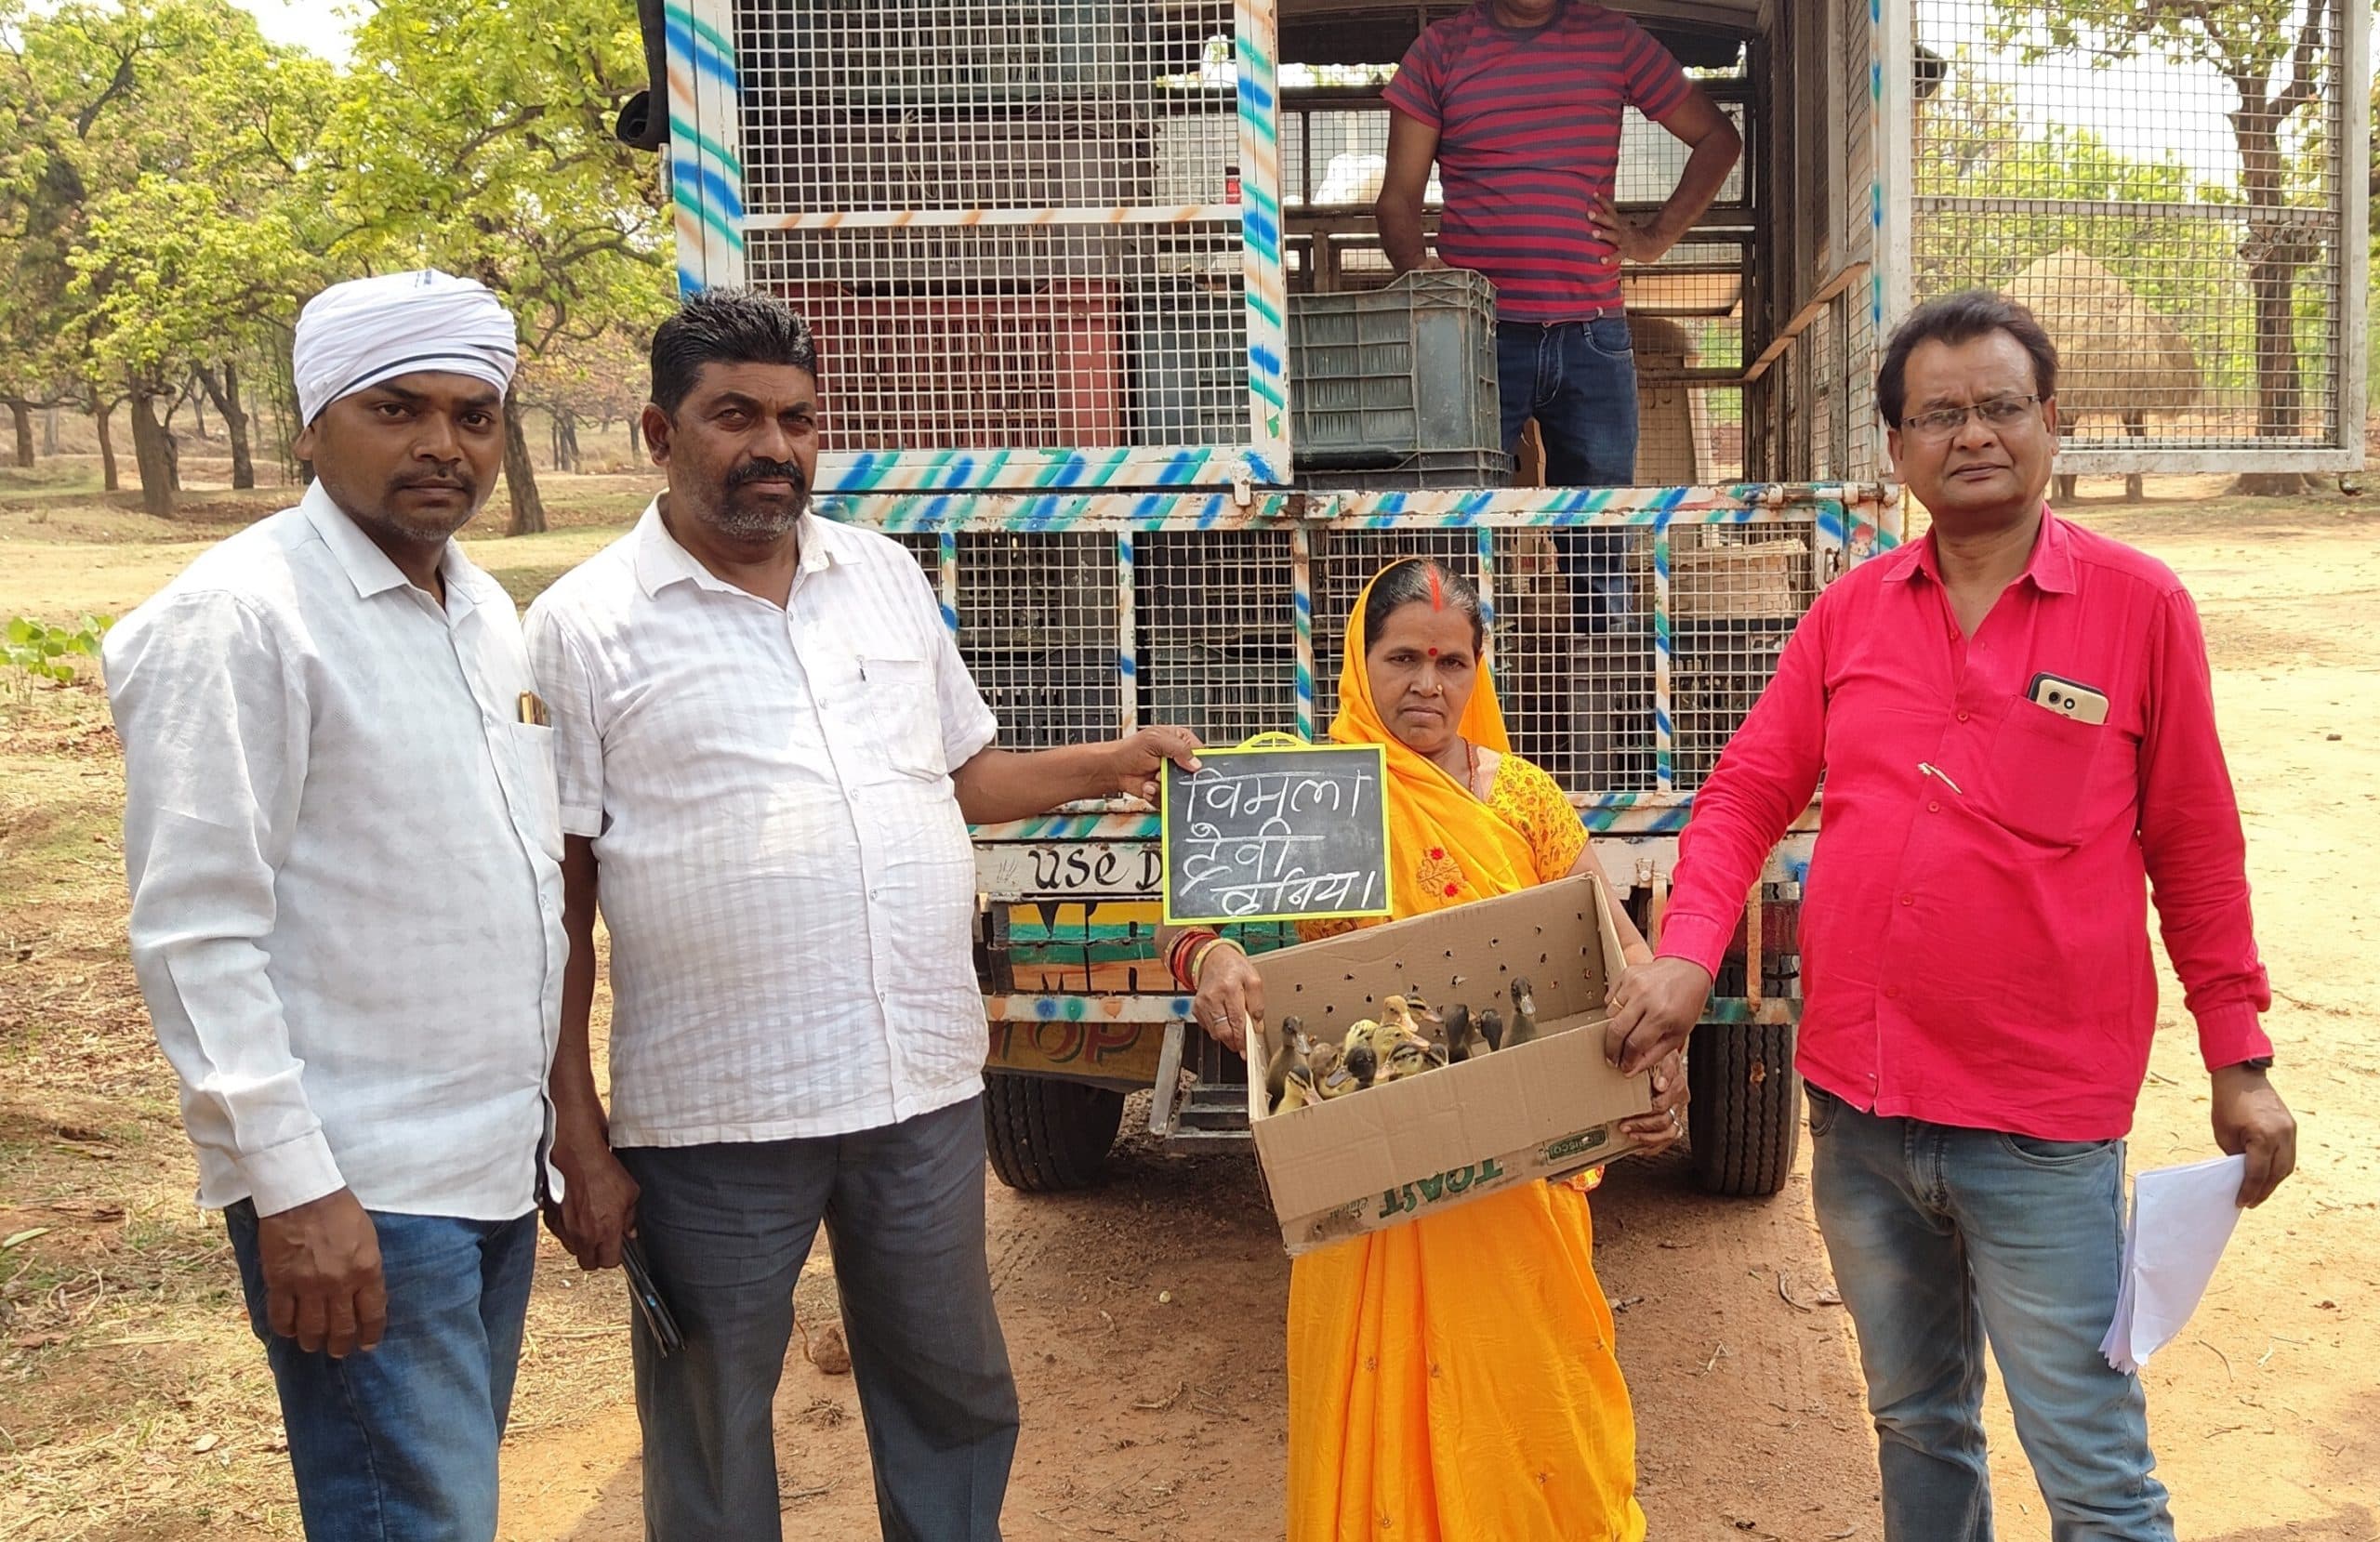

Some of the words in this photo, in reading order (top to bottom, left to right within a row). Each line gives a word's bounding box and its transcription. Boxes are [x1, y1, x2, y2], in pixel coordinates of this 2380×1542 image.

[1178, 768, 1376, 823] विमला
[1179, 817, 1327, 897] देवी
[1378, 1158, 1504, 1219] TOAST
